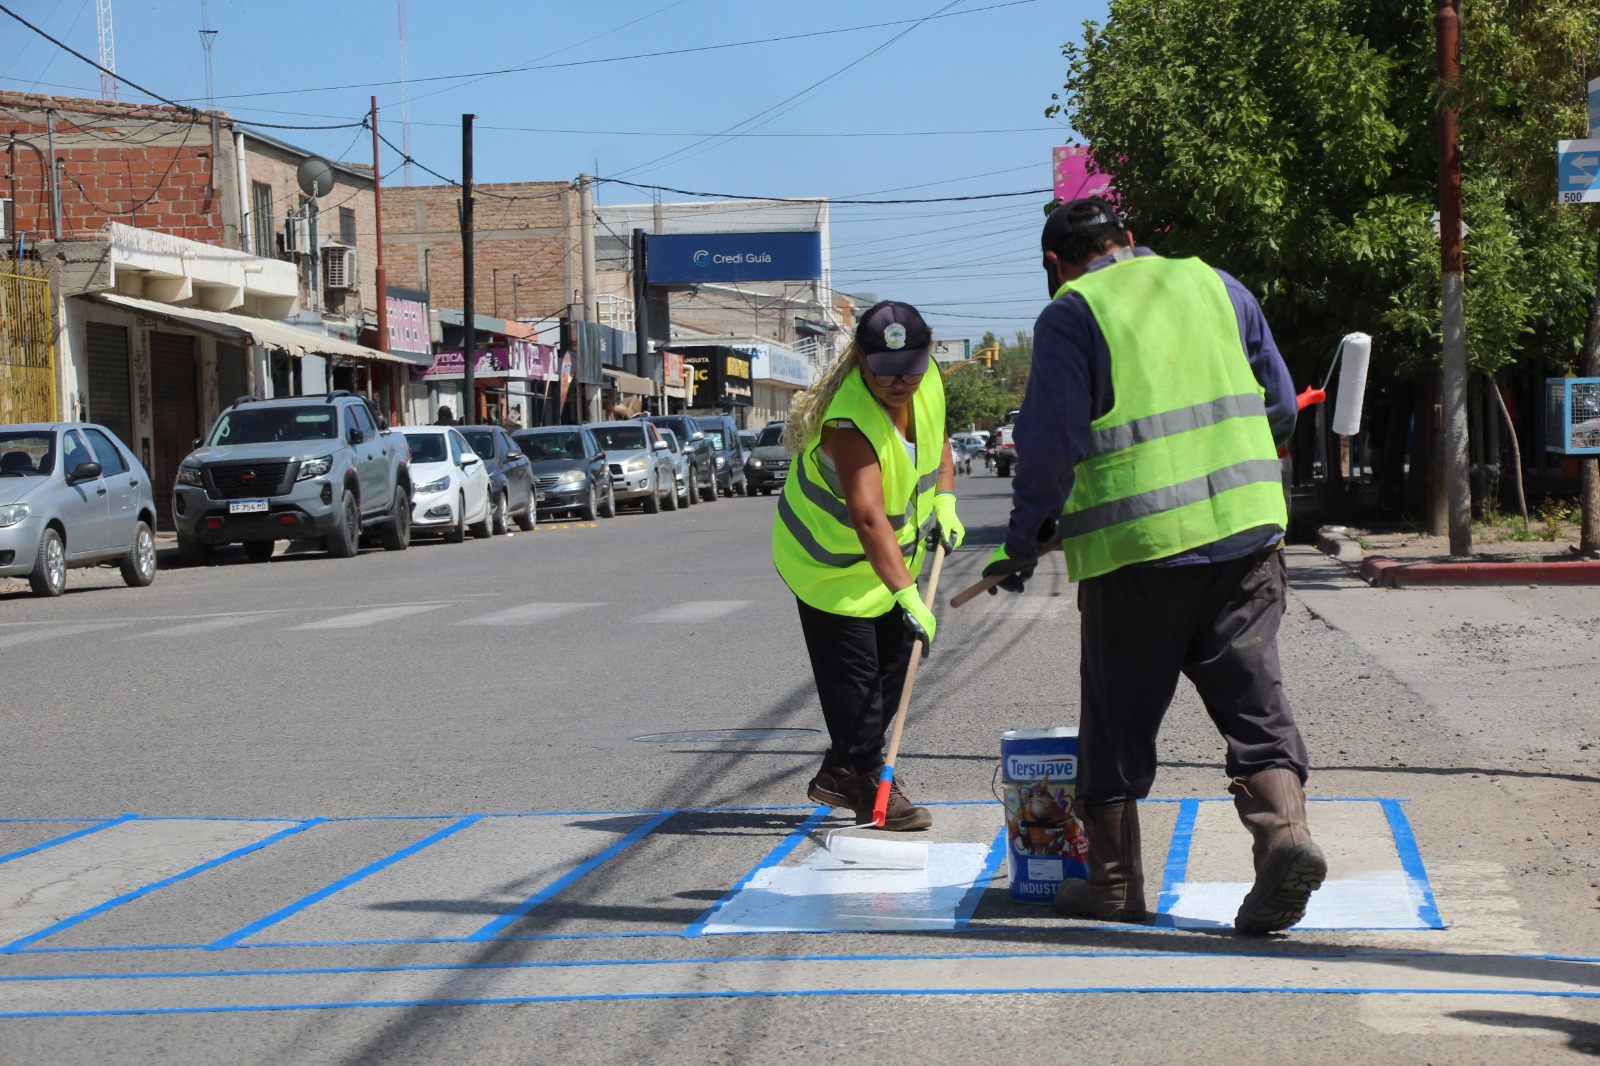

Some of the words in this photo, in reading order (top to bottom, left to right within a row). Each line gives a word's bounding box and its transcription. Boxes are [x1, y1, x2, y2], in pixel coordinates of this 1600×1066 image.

[1564, 192, 1582, 202] 500
[713, 253, 743, 264] Credi
[746, 252, 772, 263] Guía
[1010, 759, 1073, 776] Tersuave
